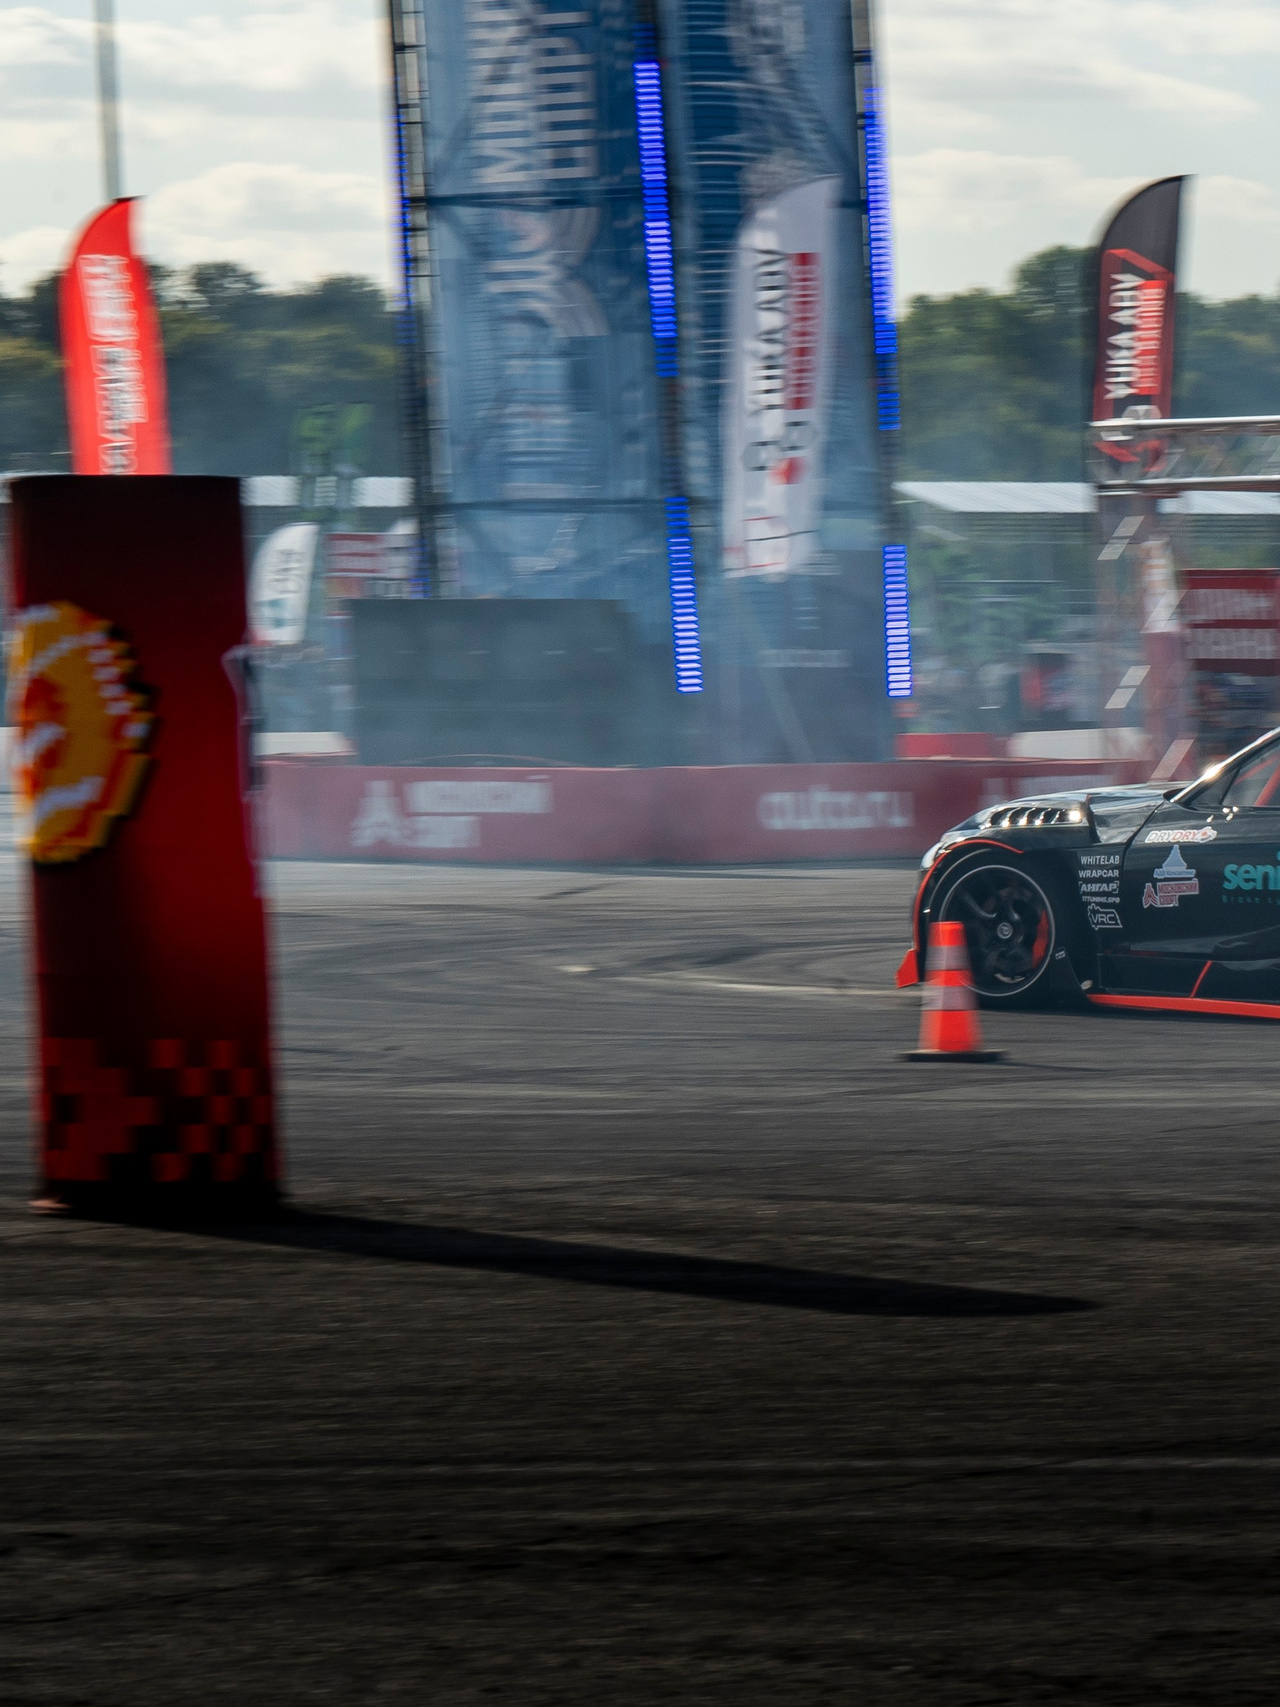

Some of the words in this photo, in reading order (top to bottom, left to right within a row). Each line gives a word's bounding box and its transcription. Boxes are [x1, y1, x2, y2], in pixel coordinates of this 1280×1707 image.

[1080, 855, 1120, 865] WHITELAB
[1078, 869, 1120, 878] WRAPCAR
[1091, 913, 1116, 924] VRC
